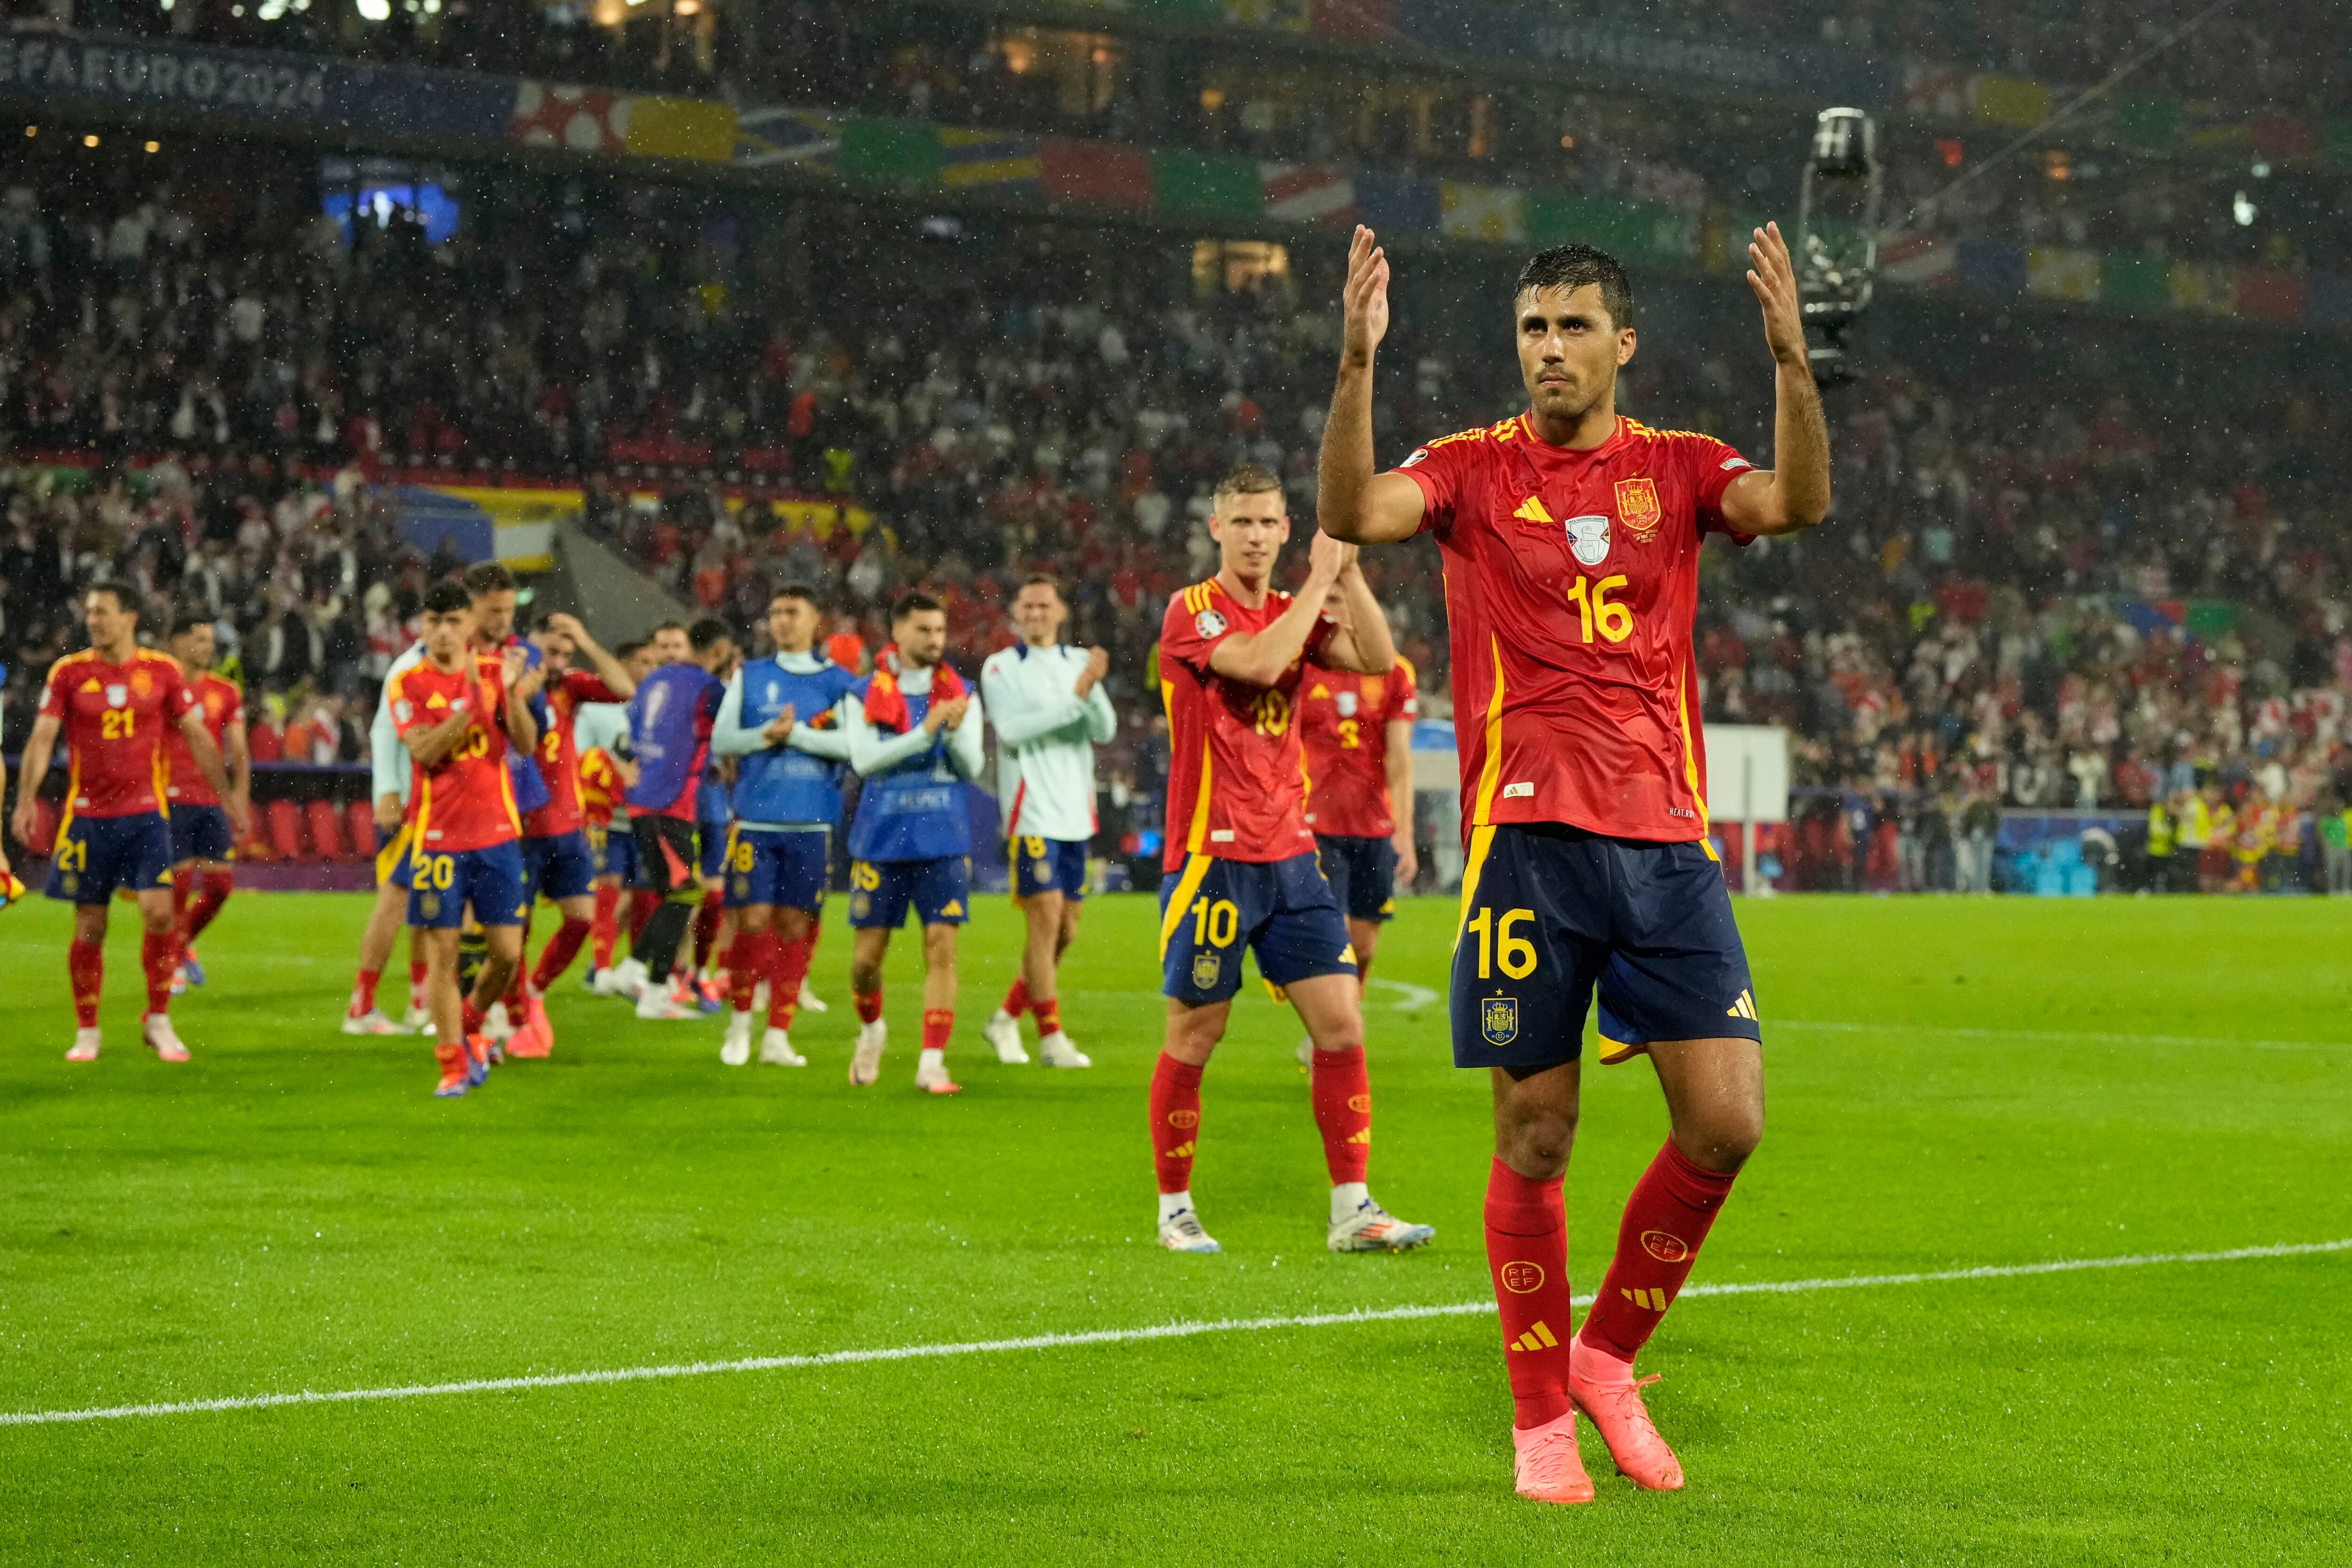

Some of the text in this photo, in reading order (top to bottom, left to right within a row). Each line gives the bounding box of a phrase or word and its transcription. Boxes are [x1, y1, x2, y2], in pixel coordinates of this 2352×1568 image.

[1567, 574, 1634, 643] 16
[102, 708, 135, 740] 21
[1249, 689, 1289, 736] 10
[1338, 719, 1359, 749] 3
[57, 838, 87, 872] 21
[413, 853, 455, 891] 20
[1191, 895, 1239, 948] 10
[1469, 907, 1537, 980] 16
